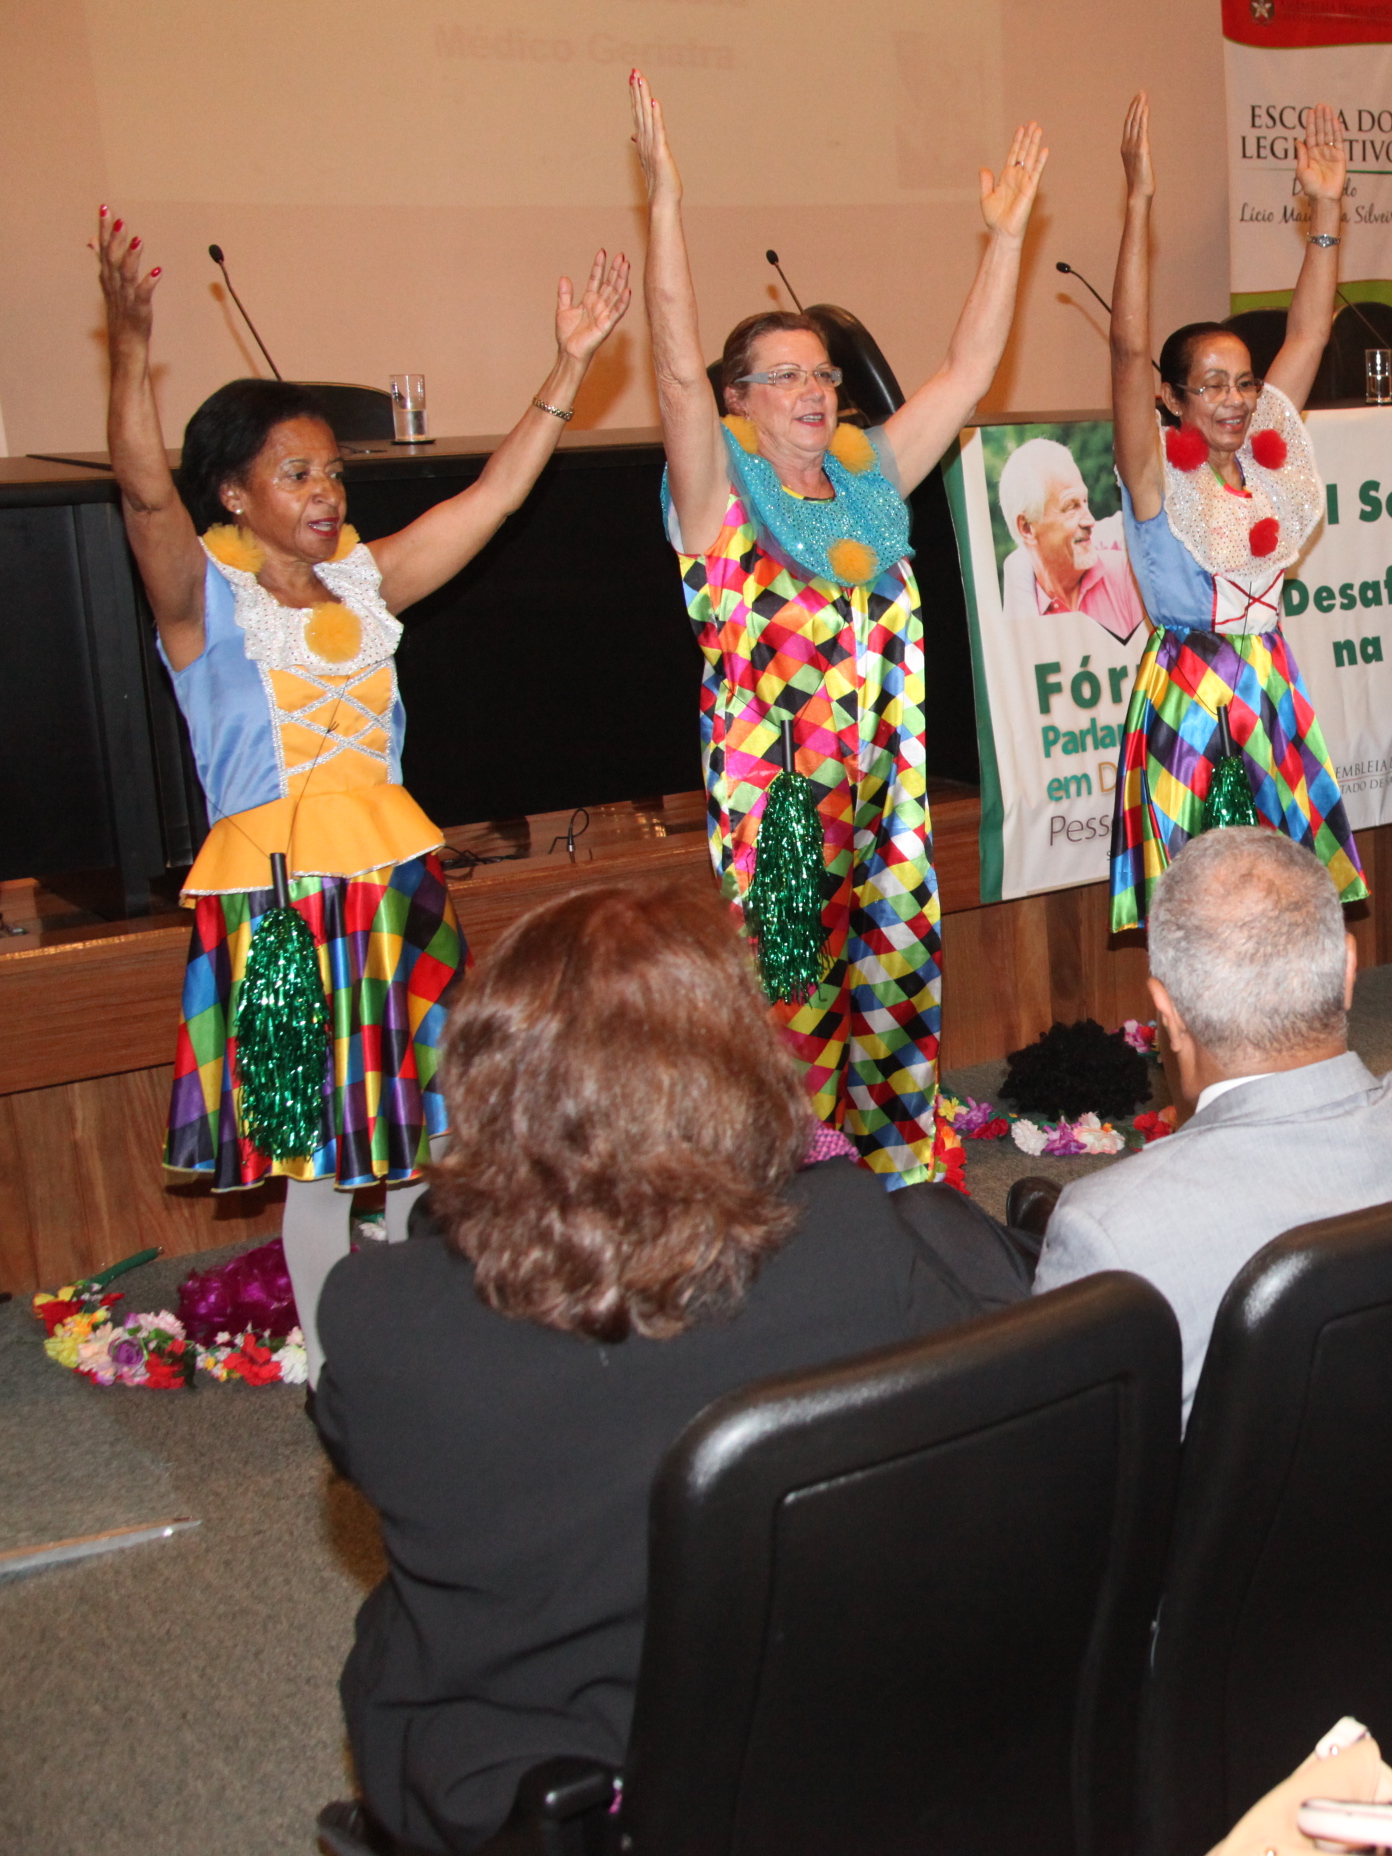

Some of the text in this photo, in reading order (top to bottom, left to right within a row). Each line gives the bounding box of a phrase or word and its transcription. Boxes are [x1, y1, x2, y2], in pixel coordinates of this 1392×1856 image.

[1250, 104, 1349, 132] ESCOA
[1332, 635, 1384, 668] na
[1034, 655, 1140, 715] Fór
[1336, 759, 1387, 779] EMBLEIA
[1047, 771, 1093, 802] em
[1340, 780, 1367, 795] TADO
[1050, 814, 1113, 846] Pess
